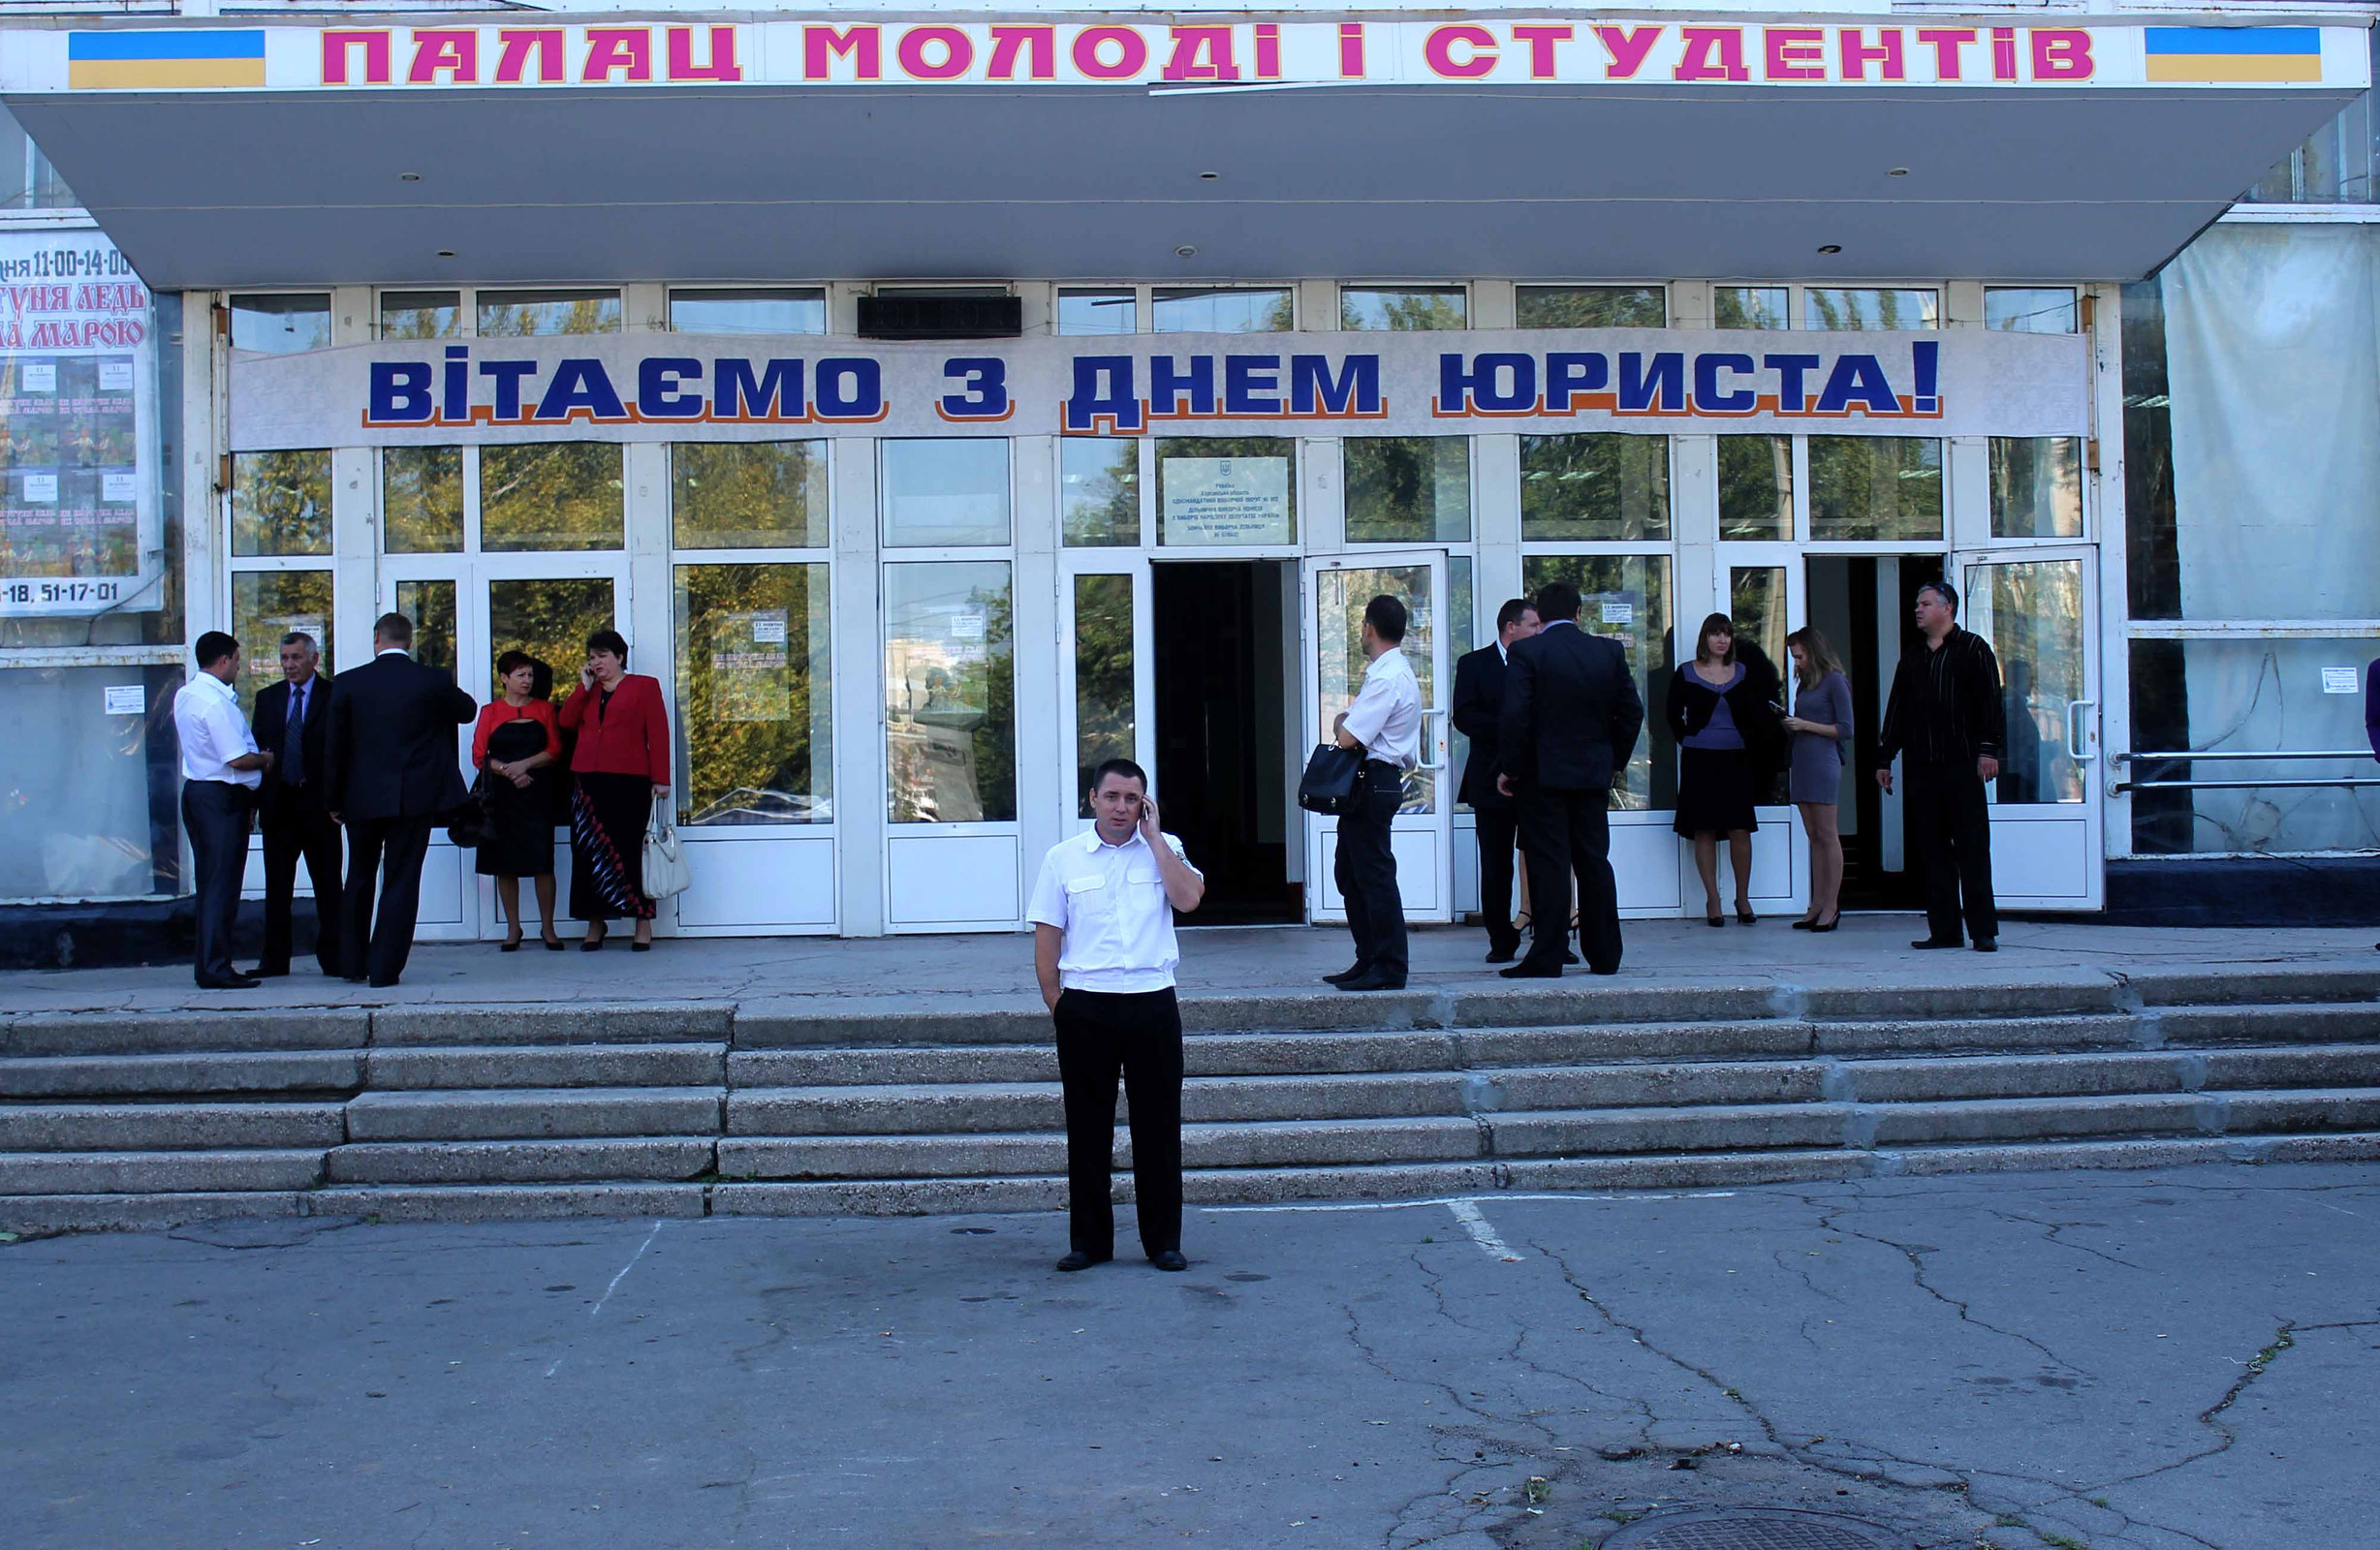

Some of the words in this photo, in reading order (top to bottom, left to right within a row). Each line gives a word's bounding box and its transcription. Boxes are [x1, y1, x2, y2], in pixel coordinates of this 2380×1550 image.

[320, 25, 743, 83] ПАЛАЦ
[0, 284, 71, 321] УНЯ
[29, 319, 145, 349] МАРОЮ
[1061, 355, 1388, 434] ДНЕМ
[1432, 341, 1943, 418] ЮРИСТА!
[41, 583, 117, 601] 51-17-01
